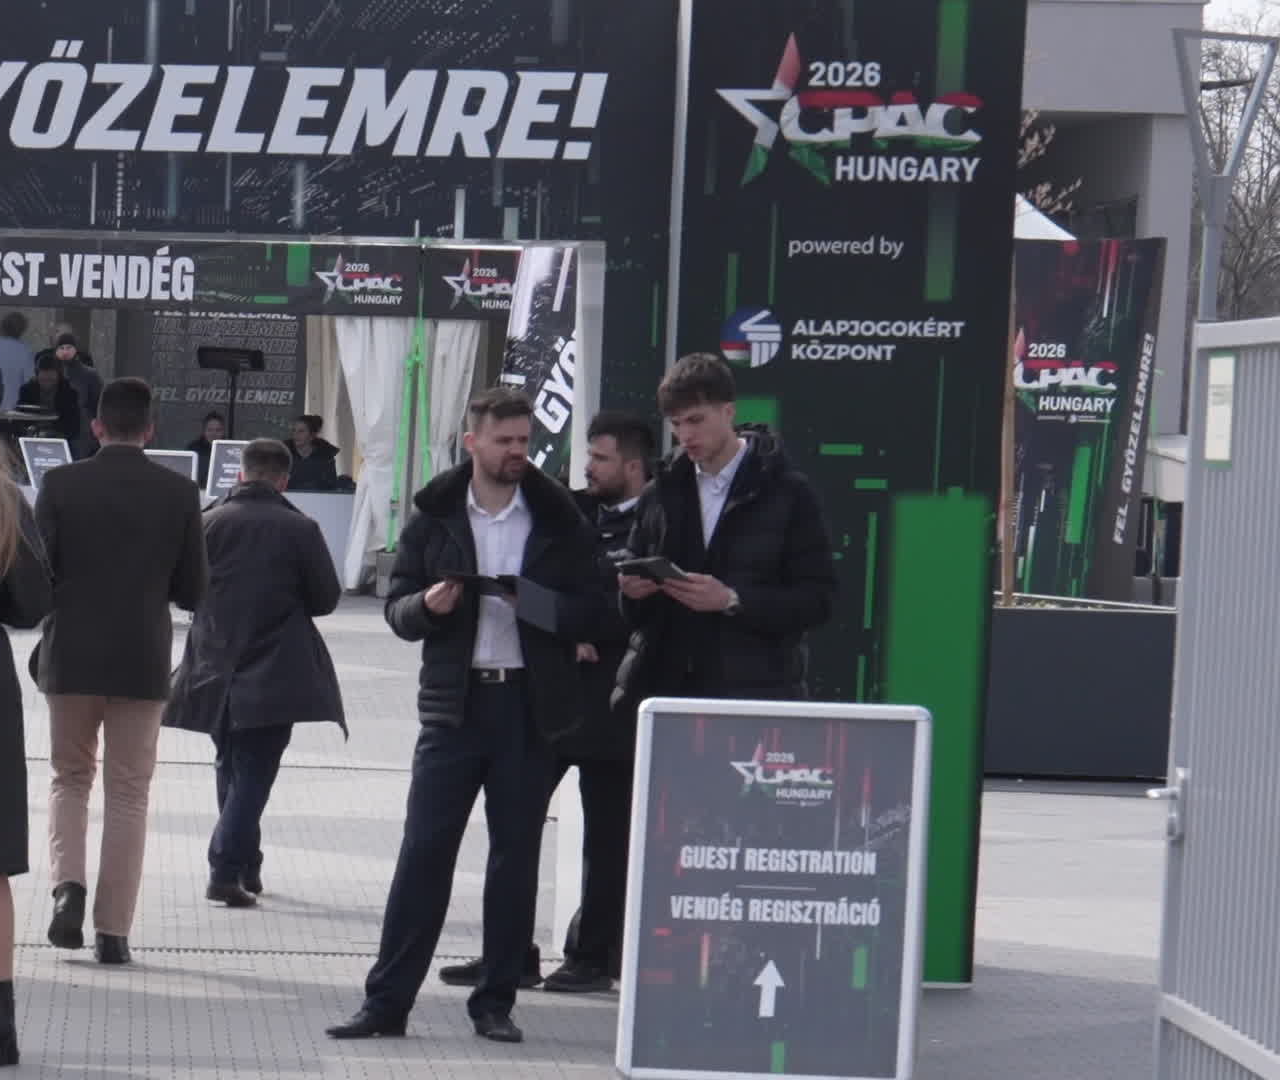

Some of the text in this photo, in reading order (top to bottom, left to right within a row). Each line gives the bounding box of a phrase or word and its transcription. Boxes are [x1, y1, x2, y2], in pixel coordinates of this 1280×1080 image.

[808, 62, 881, 87] 2026
[780, 90, 983, 151] CPAC
[835, 156, 980, 182] HUNGARY
[788, 236, 904, 260] powered by
[354, 294, 402, 305] HUNGARY
[792, 317, 965, 338] ALAPJOGOKÉRT
[792, 340, 896, 361] KÖZPONT
[1028, 343, 1067, 358] 2026
[1013, 360, 1119, 393] CPAC
[1039, 396, 1116, 412] HUNGARY
[776, 788, 833, 799] HUNGARY
[680, 846, 877, 875] GUEST REGISTRATION
[670, 893, 881, 926] VENDÉG REGISZTRÁCIÓ
